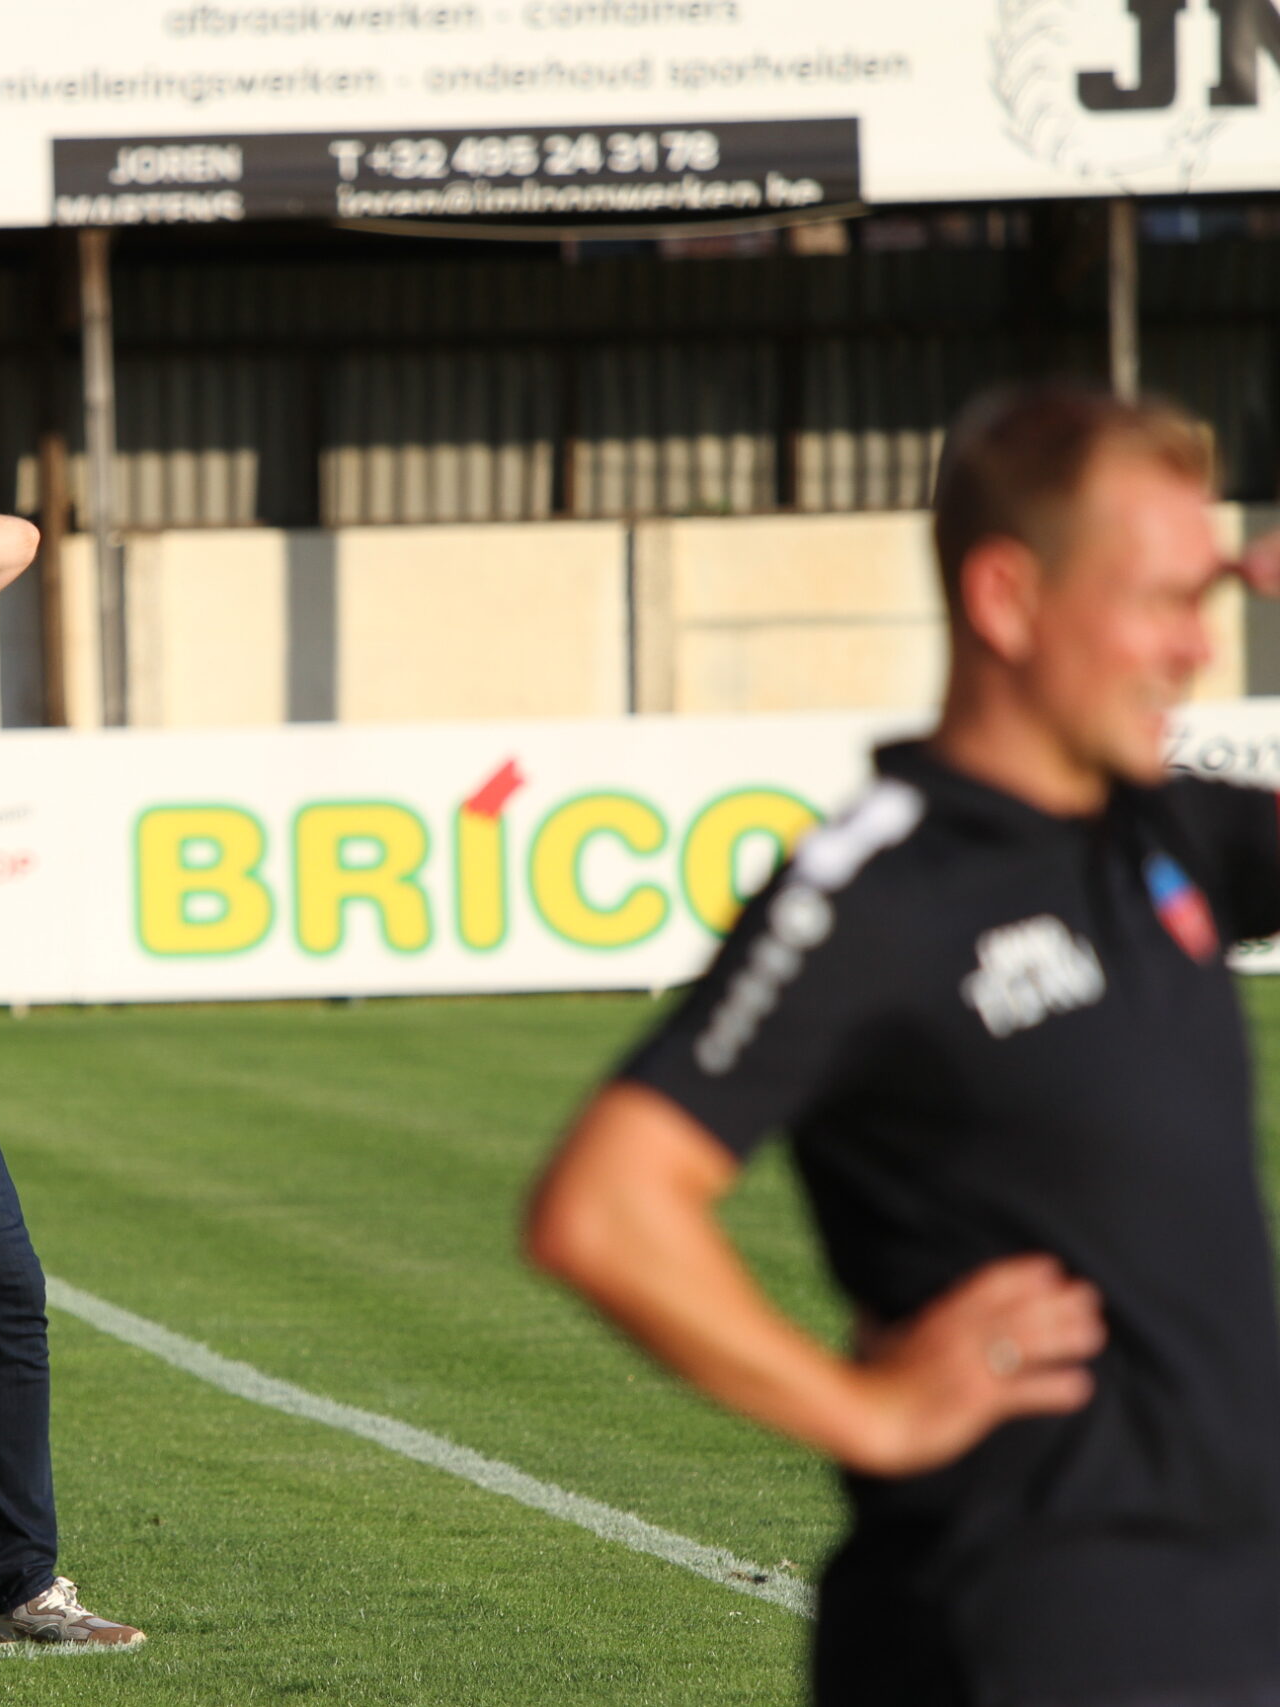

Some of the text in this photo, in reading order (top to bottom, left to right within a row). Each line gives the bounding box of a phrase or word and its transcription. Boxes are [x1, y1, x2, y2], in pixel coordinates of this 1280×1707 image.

[109, 143, 243, 185] JOREN
[328, 140, 366, 181] T
[543, 132, 604, 175] 24
[606, 131, 659, 173] 31
[660, 129, 720, 172] 78
